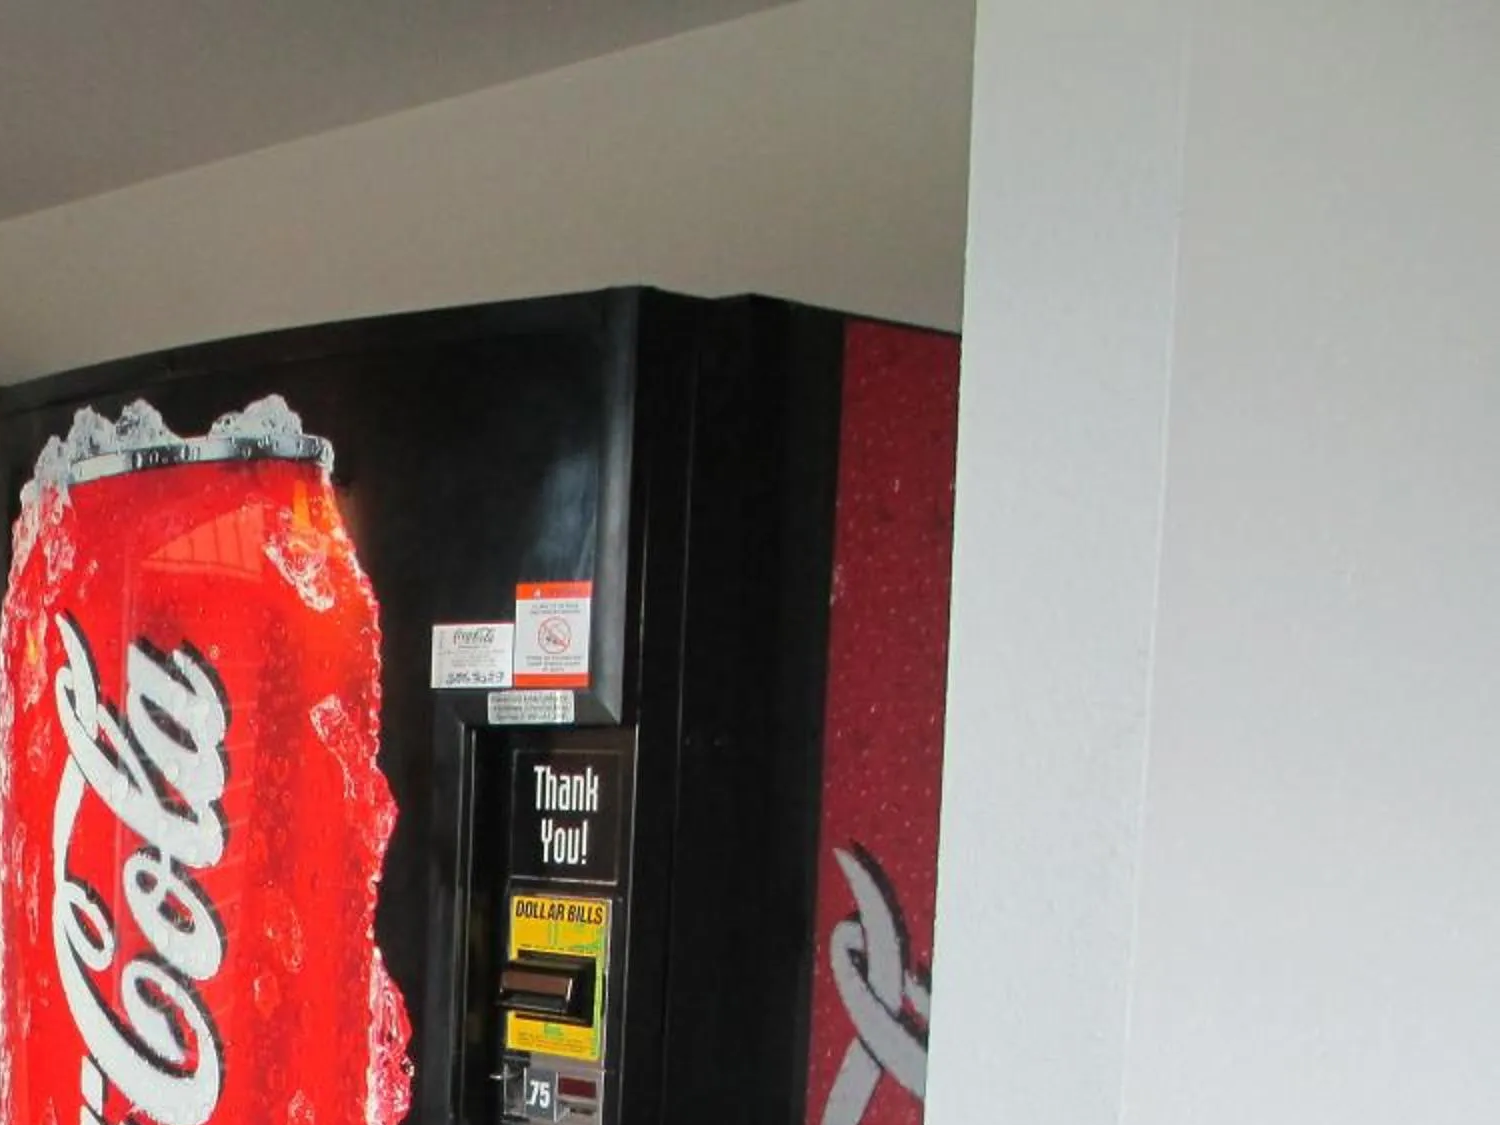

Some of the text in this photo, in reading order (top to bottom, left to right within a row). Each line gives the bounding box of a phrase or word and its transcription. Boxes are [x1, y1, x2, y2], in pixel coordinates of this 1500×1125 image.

[533, 765, 599, 812] Thank
[541, 818, 589, 865] You!
[515, 900, 603, 925] DOLLAR BILLS
